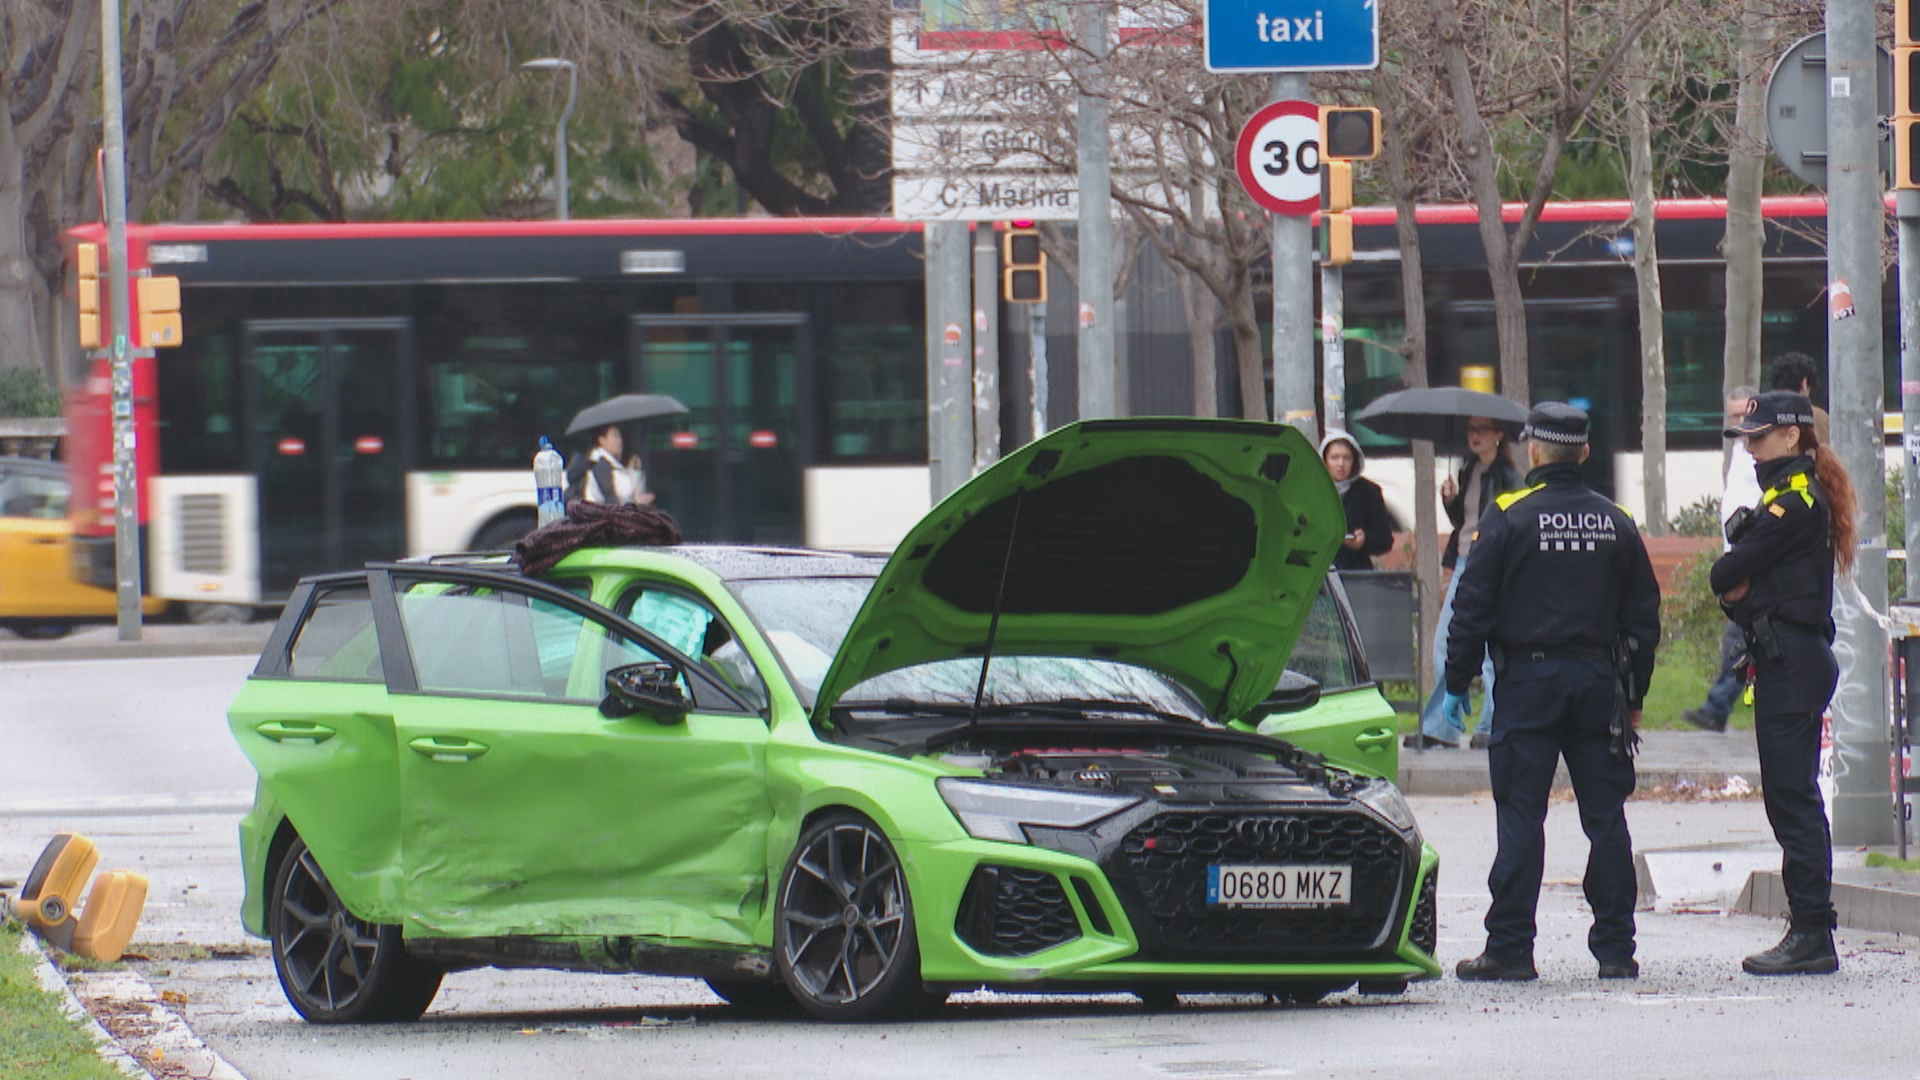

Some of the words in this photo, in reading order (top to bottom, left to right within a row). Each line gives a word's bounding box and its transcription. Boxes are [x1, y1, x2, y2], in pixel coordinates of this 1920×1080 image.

[1257, 11, 1324, 42] taxi
[1263, 139, 1320, 176] 30
[941, 184, 967, 207] C.
[980, 182, 1070, 207] Marina
[1538, 513, 1616, 531] POLICIA
[1582, 530, 1617, 541] urbana
[1223, 871, 1286, 899] 0680
[1296, 871, 1343, 899] MKZ
